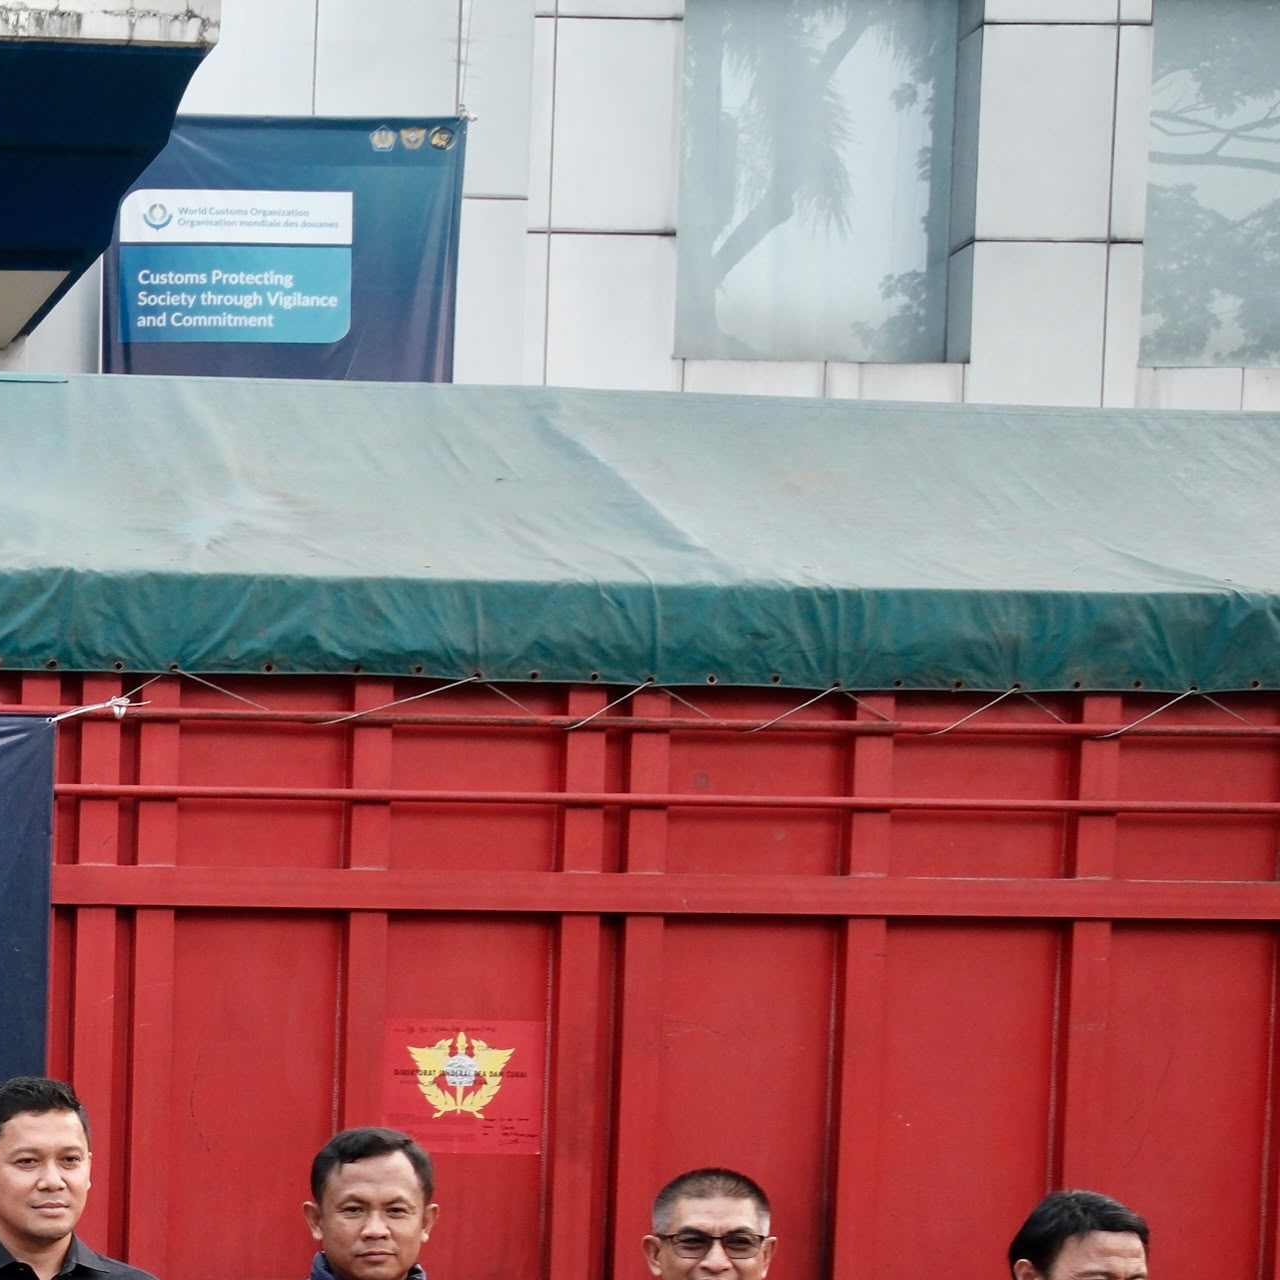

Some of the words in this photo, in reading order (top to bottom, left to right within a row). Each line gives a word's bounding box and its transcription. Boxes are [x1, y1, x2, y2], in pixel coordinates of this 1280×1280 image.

[178, 206, 207, 216] World
[209, 207, 247, 217] Customs
[249, 207, 310, 219] Organization
[137, 269, 207, 285] Customs
[211, 270, 293, 288] Protecting
[137, 291, 196, 308] Society
[200, 291, 262, 309] through
[266, 291, 337, 308] Vigilance
[137, 312, 166, 327] and
[170, 312, 274, 328] Commitment
